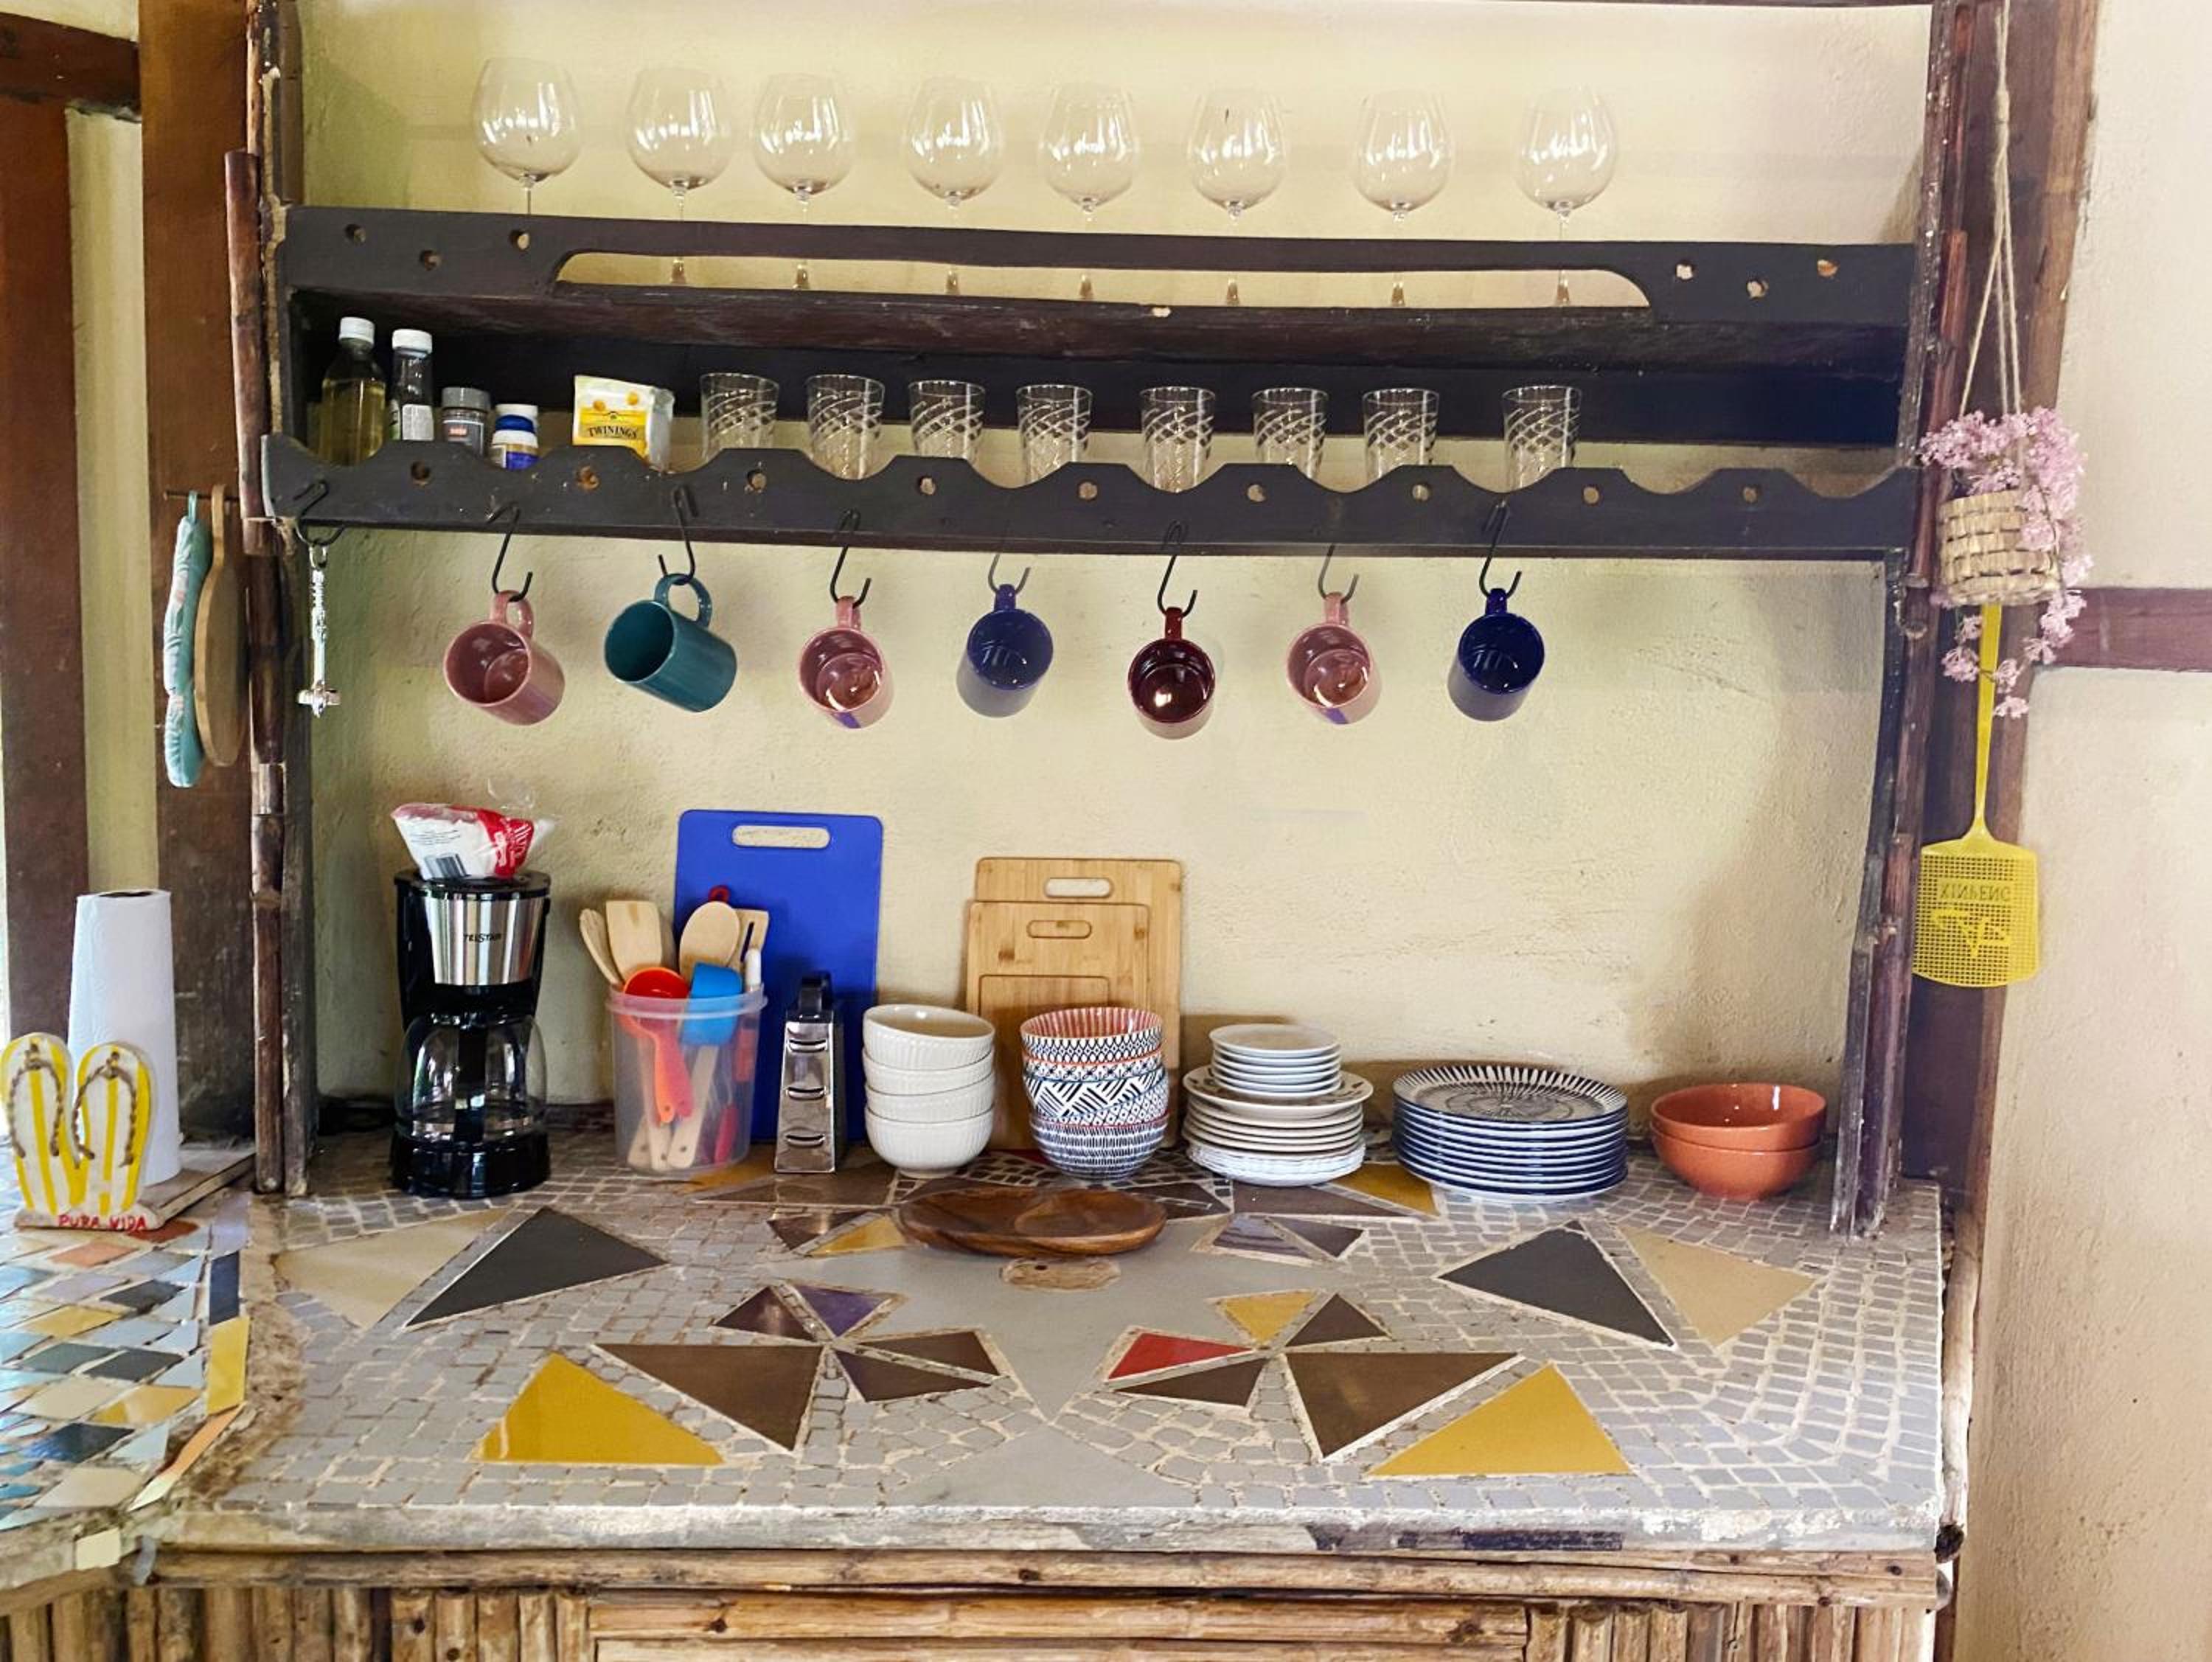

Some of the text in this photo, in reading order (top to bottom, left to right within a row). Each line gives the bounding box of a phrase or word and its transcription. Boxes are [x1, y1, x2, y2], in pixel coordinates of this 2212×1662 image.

[588, 425, 638, 439] TWININGS
[58, 1214, 146, 1231] PURA VIDA
